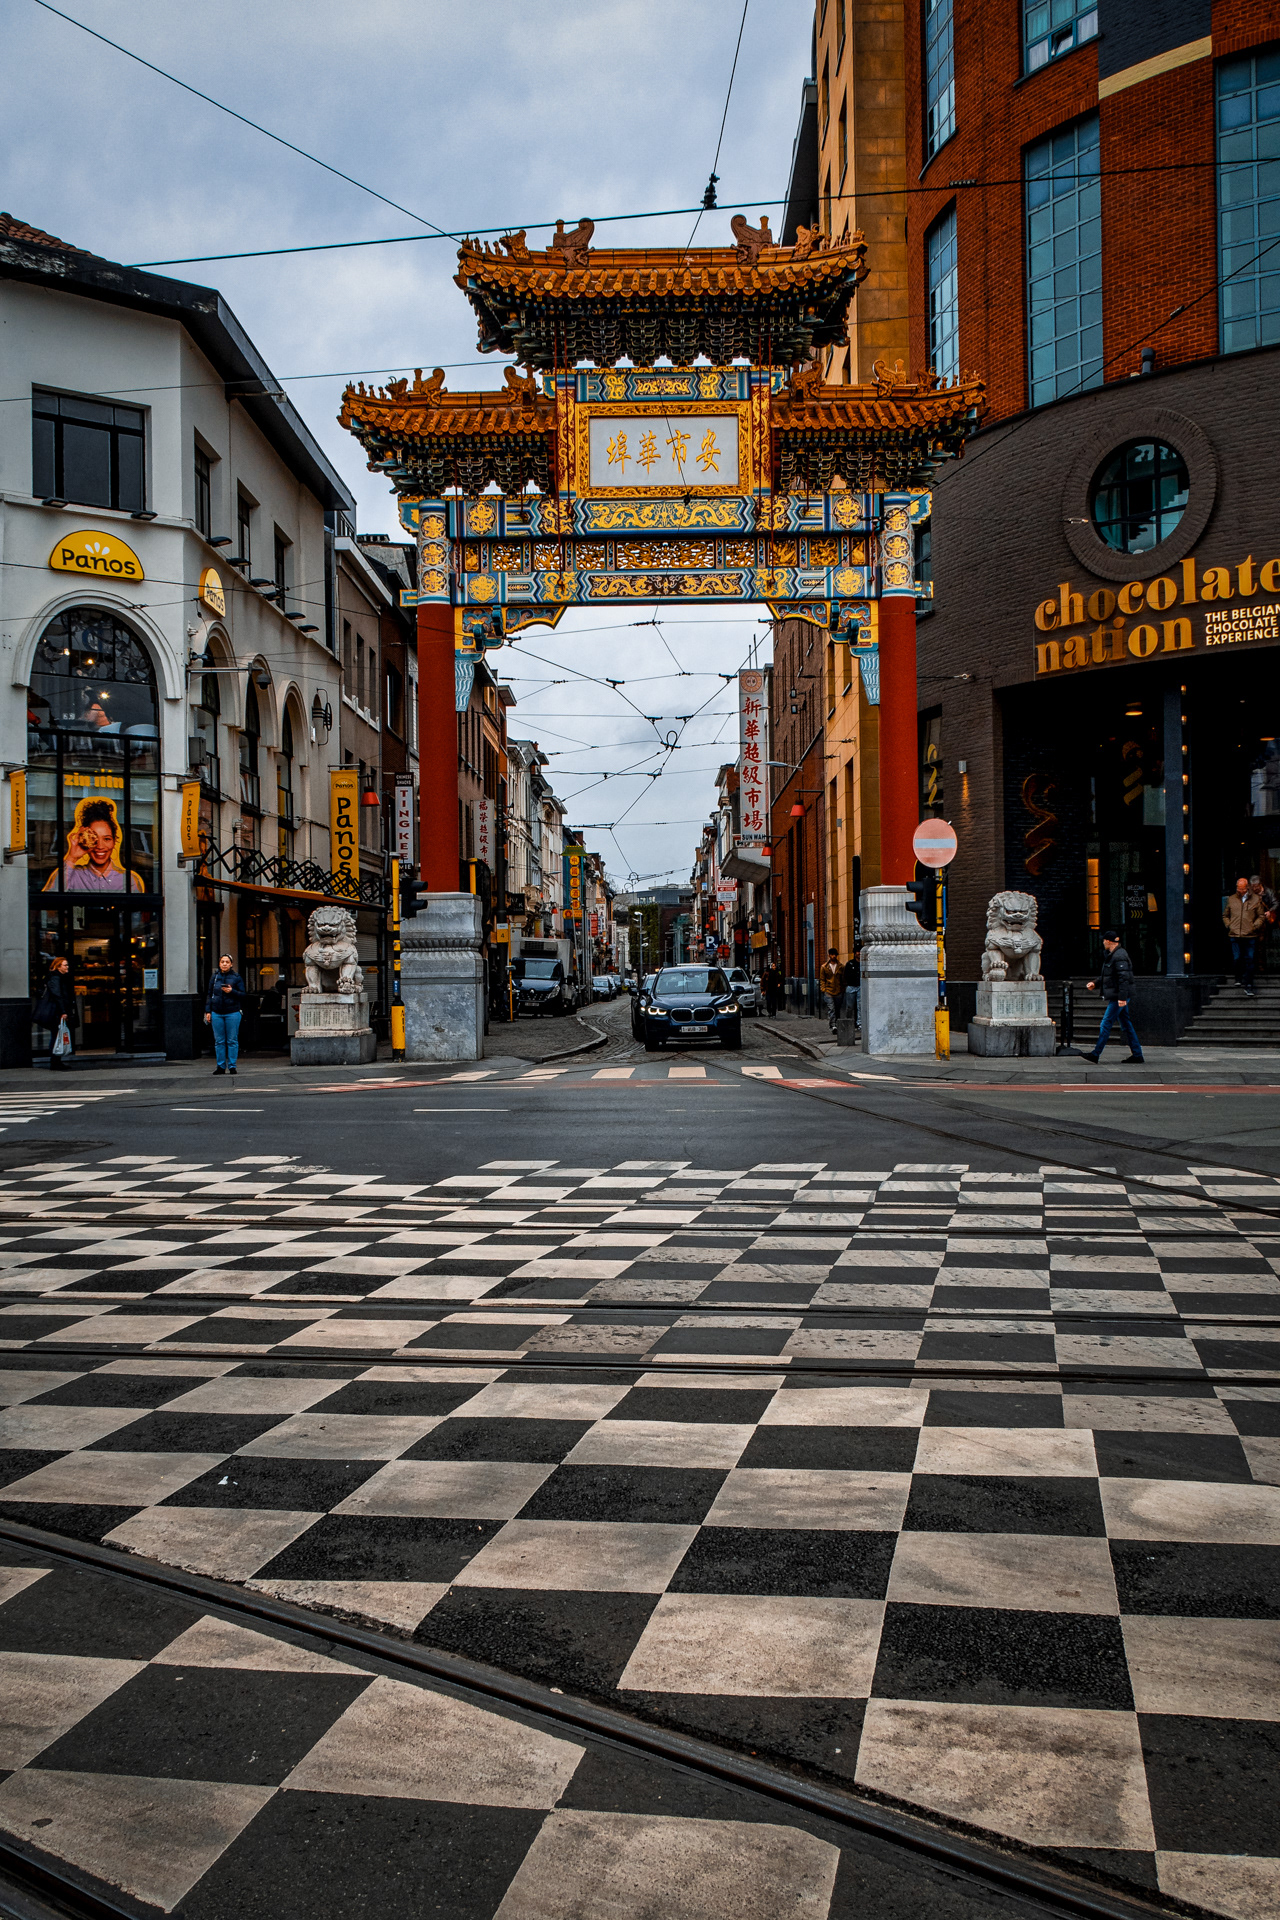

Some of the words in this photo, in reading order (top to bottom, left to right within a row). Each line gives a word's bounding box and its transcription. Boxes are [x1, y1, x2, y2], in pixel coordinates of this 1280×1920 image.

[61, 548, 136, 576] Panos
[206, 582, 225, 613] Panos
[1034, 554, 1280, 631] chocolate
[1204, 610, 1228, 623] THE
[1205, 615, 1278, 635] CHOCOLATE
[1035, 616, 1196, 675] nation
[1205, 626, 1279, 646] EXPERIENCE
[742, 696, 763, 832] 新華超級市場
[398, 789, 410, 828] TING
[334, 797, 356, 876] Panos
[706, 935, 715, 948] P
